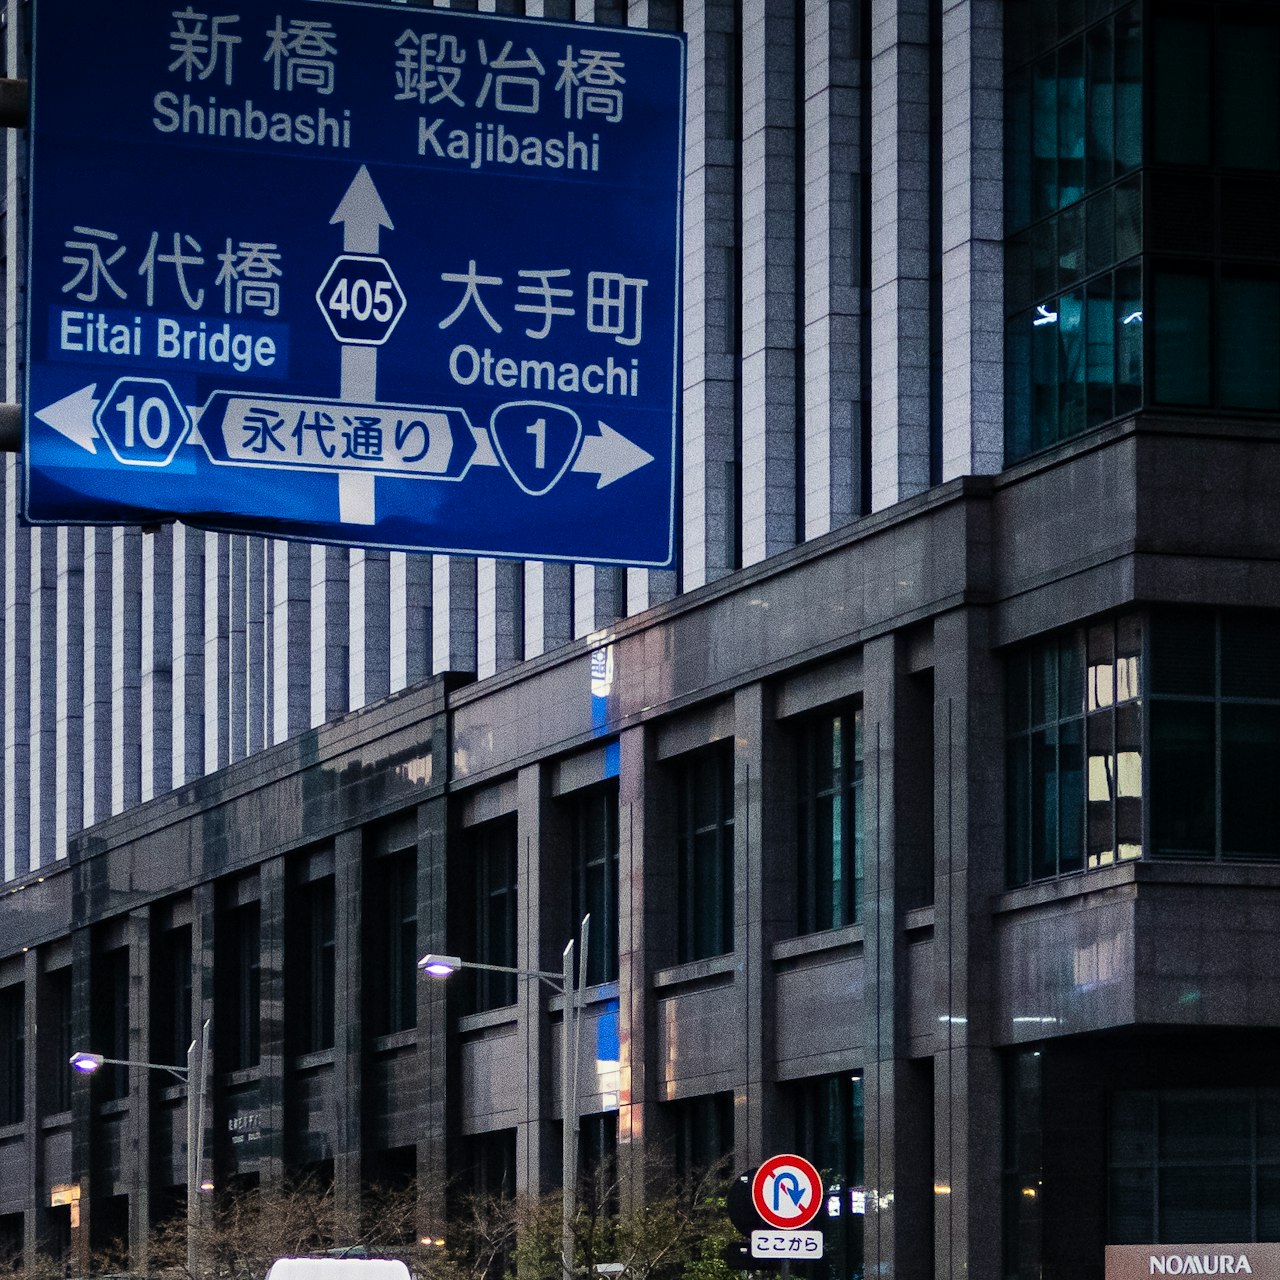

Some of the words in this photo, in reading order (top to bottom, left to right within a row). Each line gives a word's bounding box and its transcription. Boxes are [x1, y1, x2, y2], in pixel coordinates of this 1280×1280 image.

[168, 6, 338, 95] 新橋
[394, 28, 626, 123] 鍛冶橋
[153, 91, 351, 149] Shinbashi
[418, 117, 600, 171] Kajibashi
[62, 225, 283, 317] 永代橋
[328, 279, 393, 323] 405
[439, 260, 648, 346] 大手町
[60, 310, 142, 355] Eitai
[157, 319, 277, 373] Bridge
[449, 344, 640, 397] Otemachi
[115, 395, 171, 434] 10
[242, 409, 431, 463] 永代通り
[525, 418, 547, 470] 1
[757, 1237, 818, 1252] ここから
[1149, 1255, 1253, 1275] NOMURA
